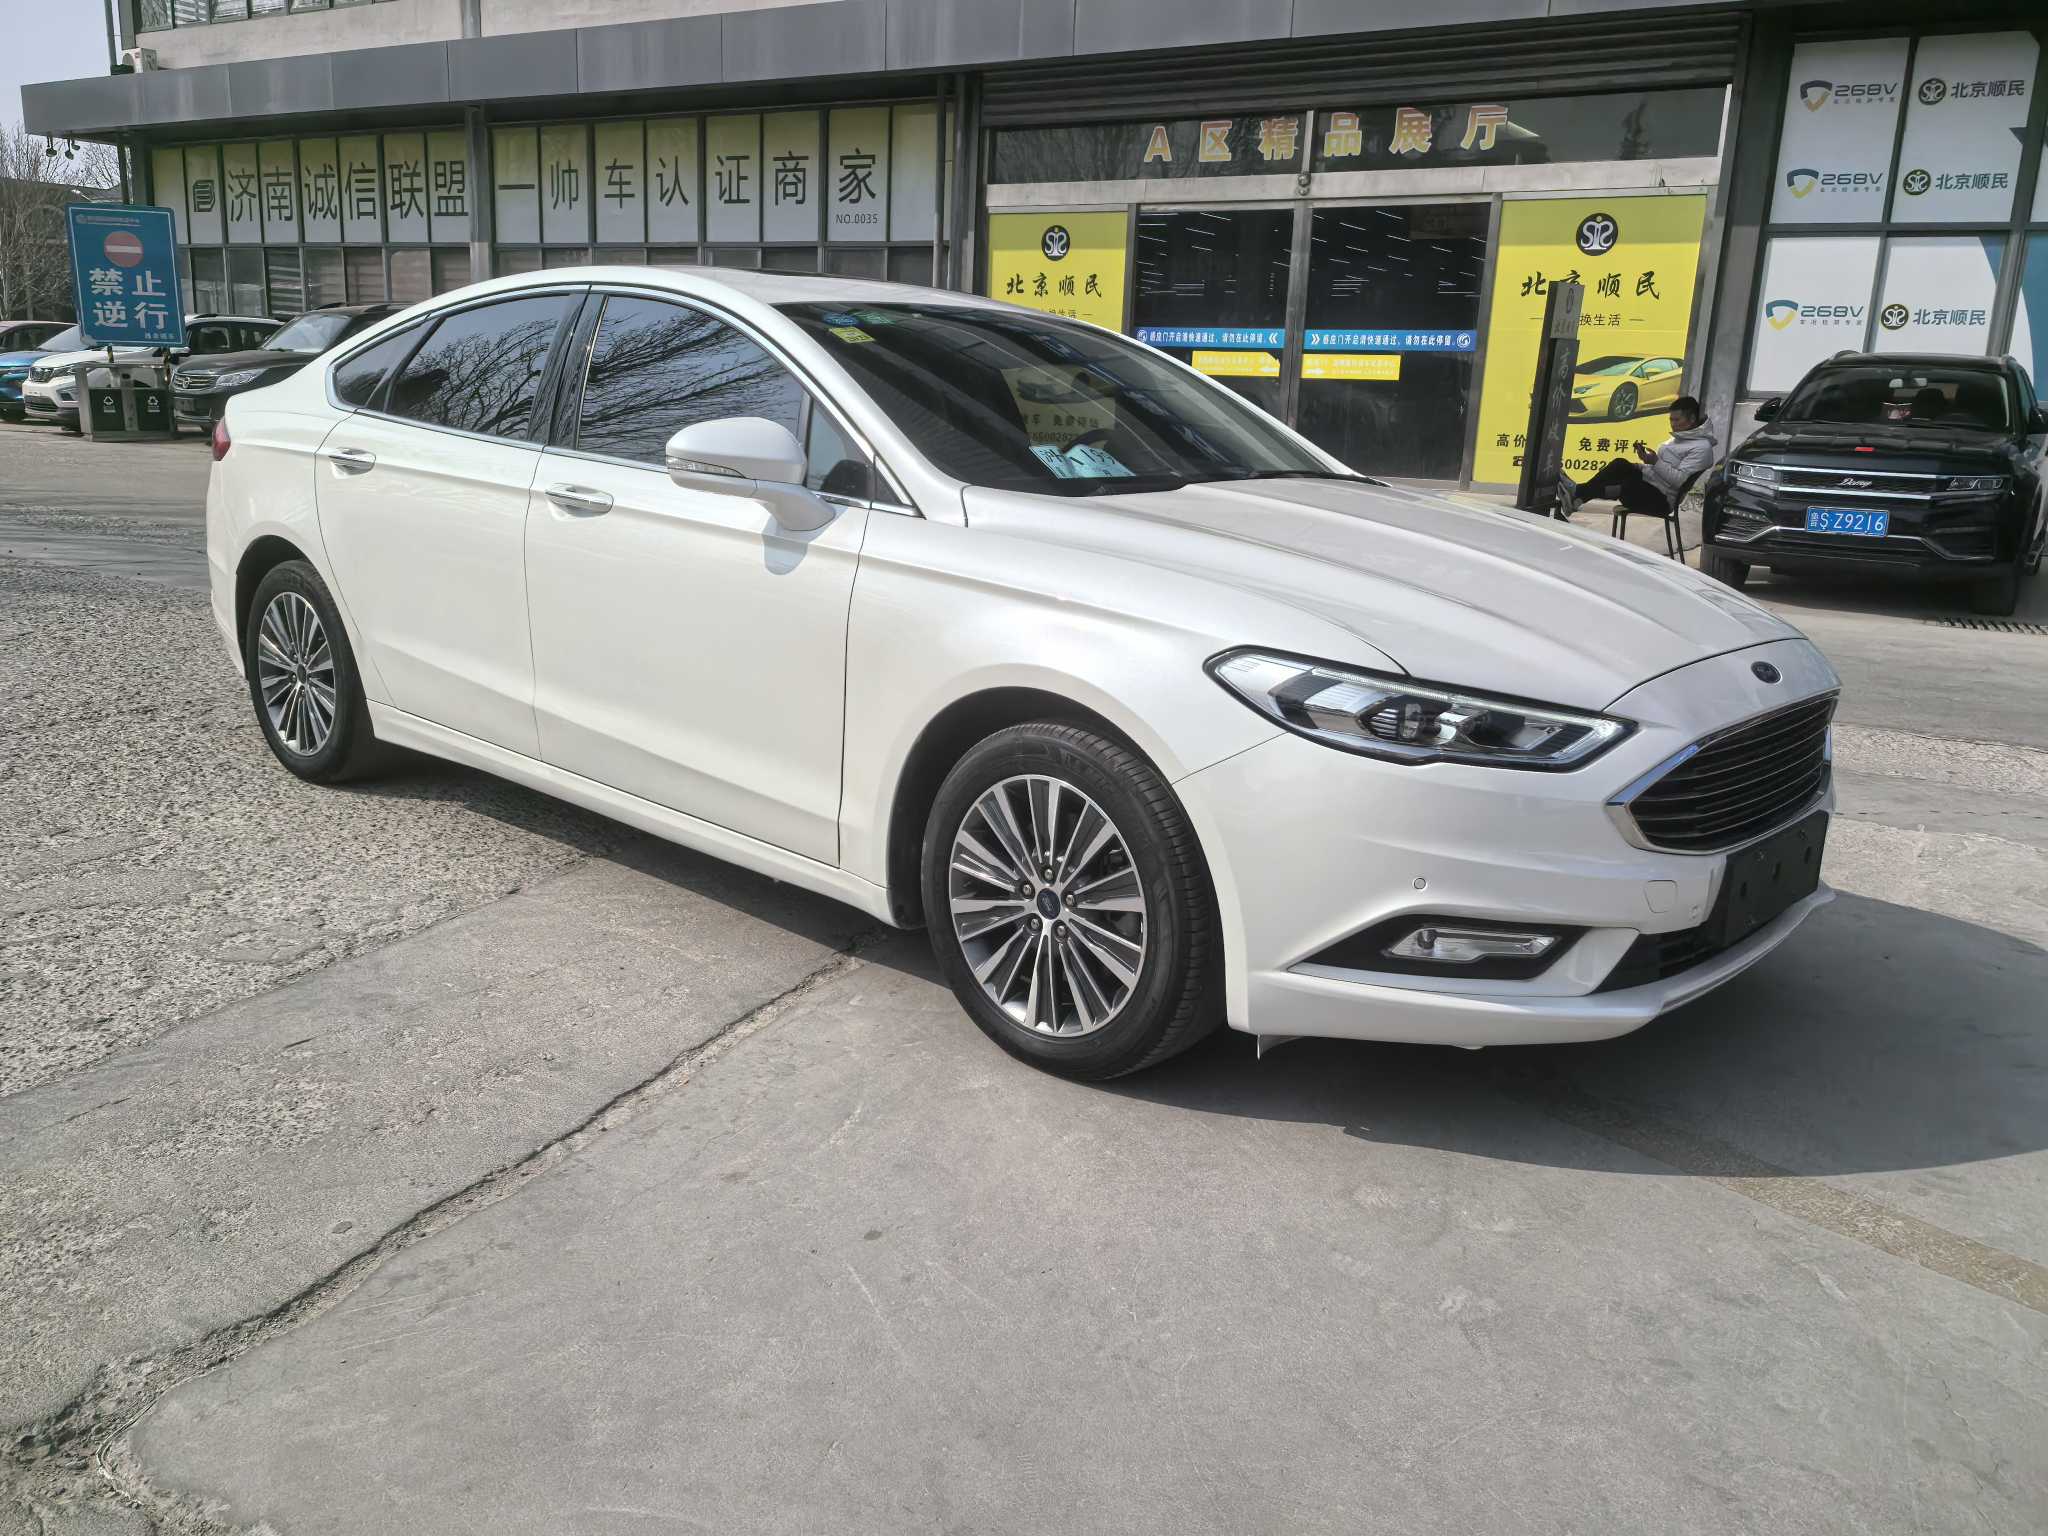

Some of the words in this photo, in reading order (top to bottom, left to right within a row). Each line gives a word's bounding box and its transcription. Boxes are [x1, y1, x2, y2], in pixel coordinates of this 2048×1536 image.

[1834, 83, 1897, 97] 268V
[1951, 80, 2025, 98] 北京顺民
[1143, 104, 1508, 162] A区精品展厅
[1821, 172, 1884, 185] 268V
[1935, 173, 2008, 190] 北京顺民
[228, 160, 469, 222] 济南诚信联盟
[835, 213, 878, 224] NO.0035
[88, 267, 166, 297] 禁止
[1006, 271, 1102, 298] 北京顺民
[93, 301, 169, 330] 逆行
[1801, 305, 1864, 318] 268V
[1912, 308, 1986, 326] 北京顺民
